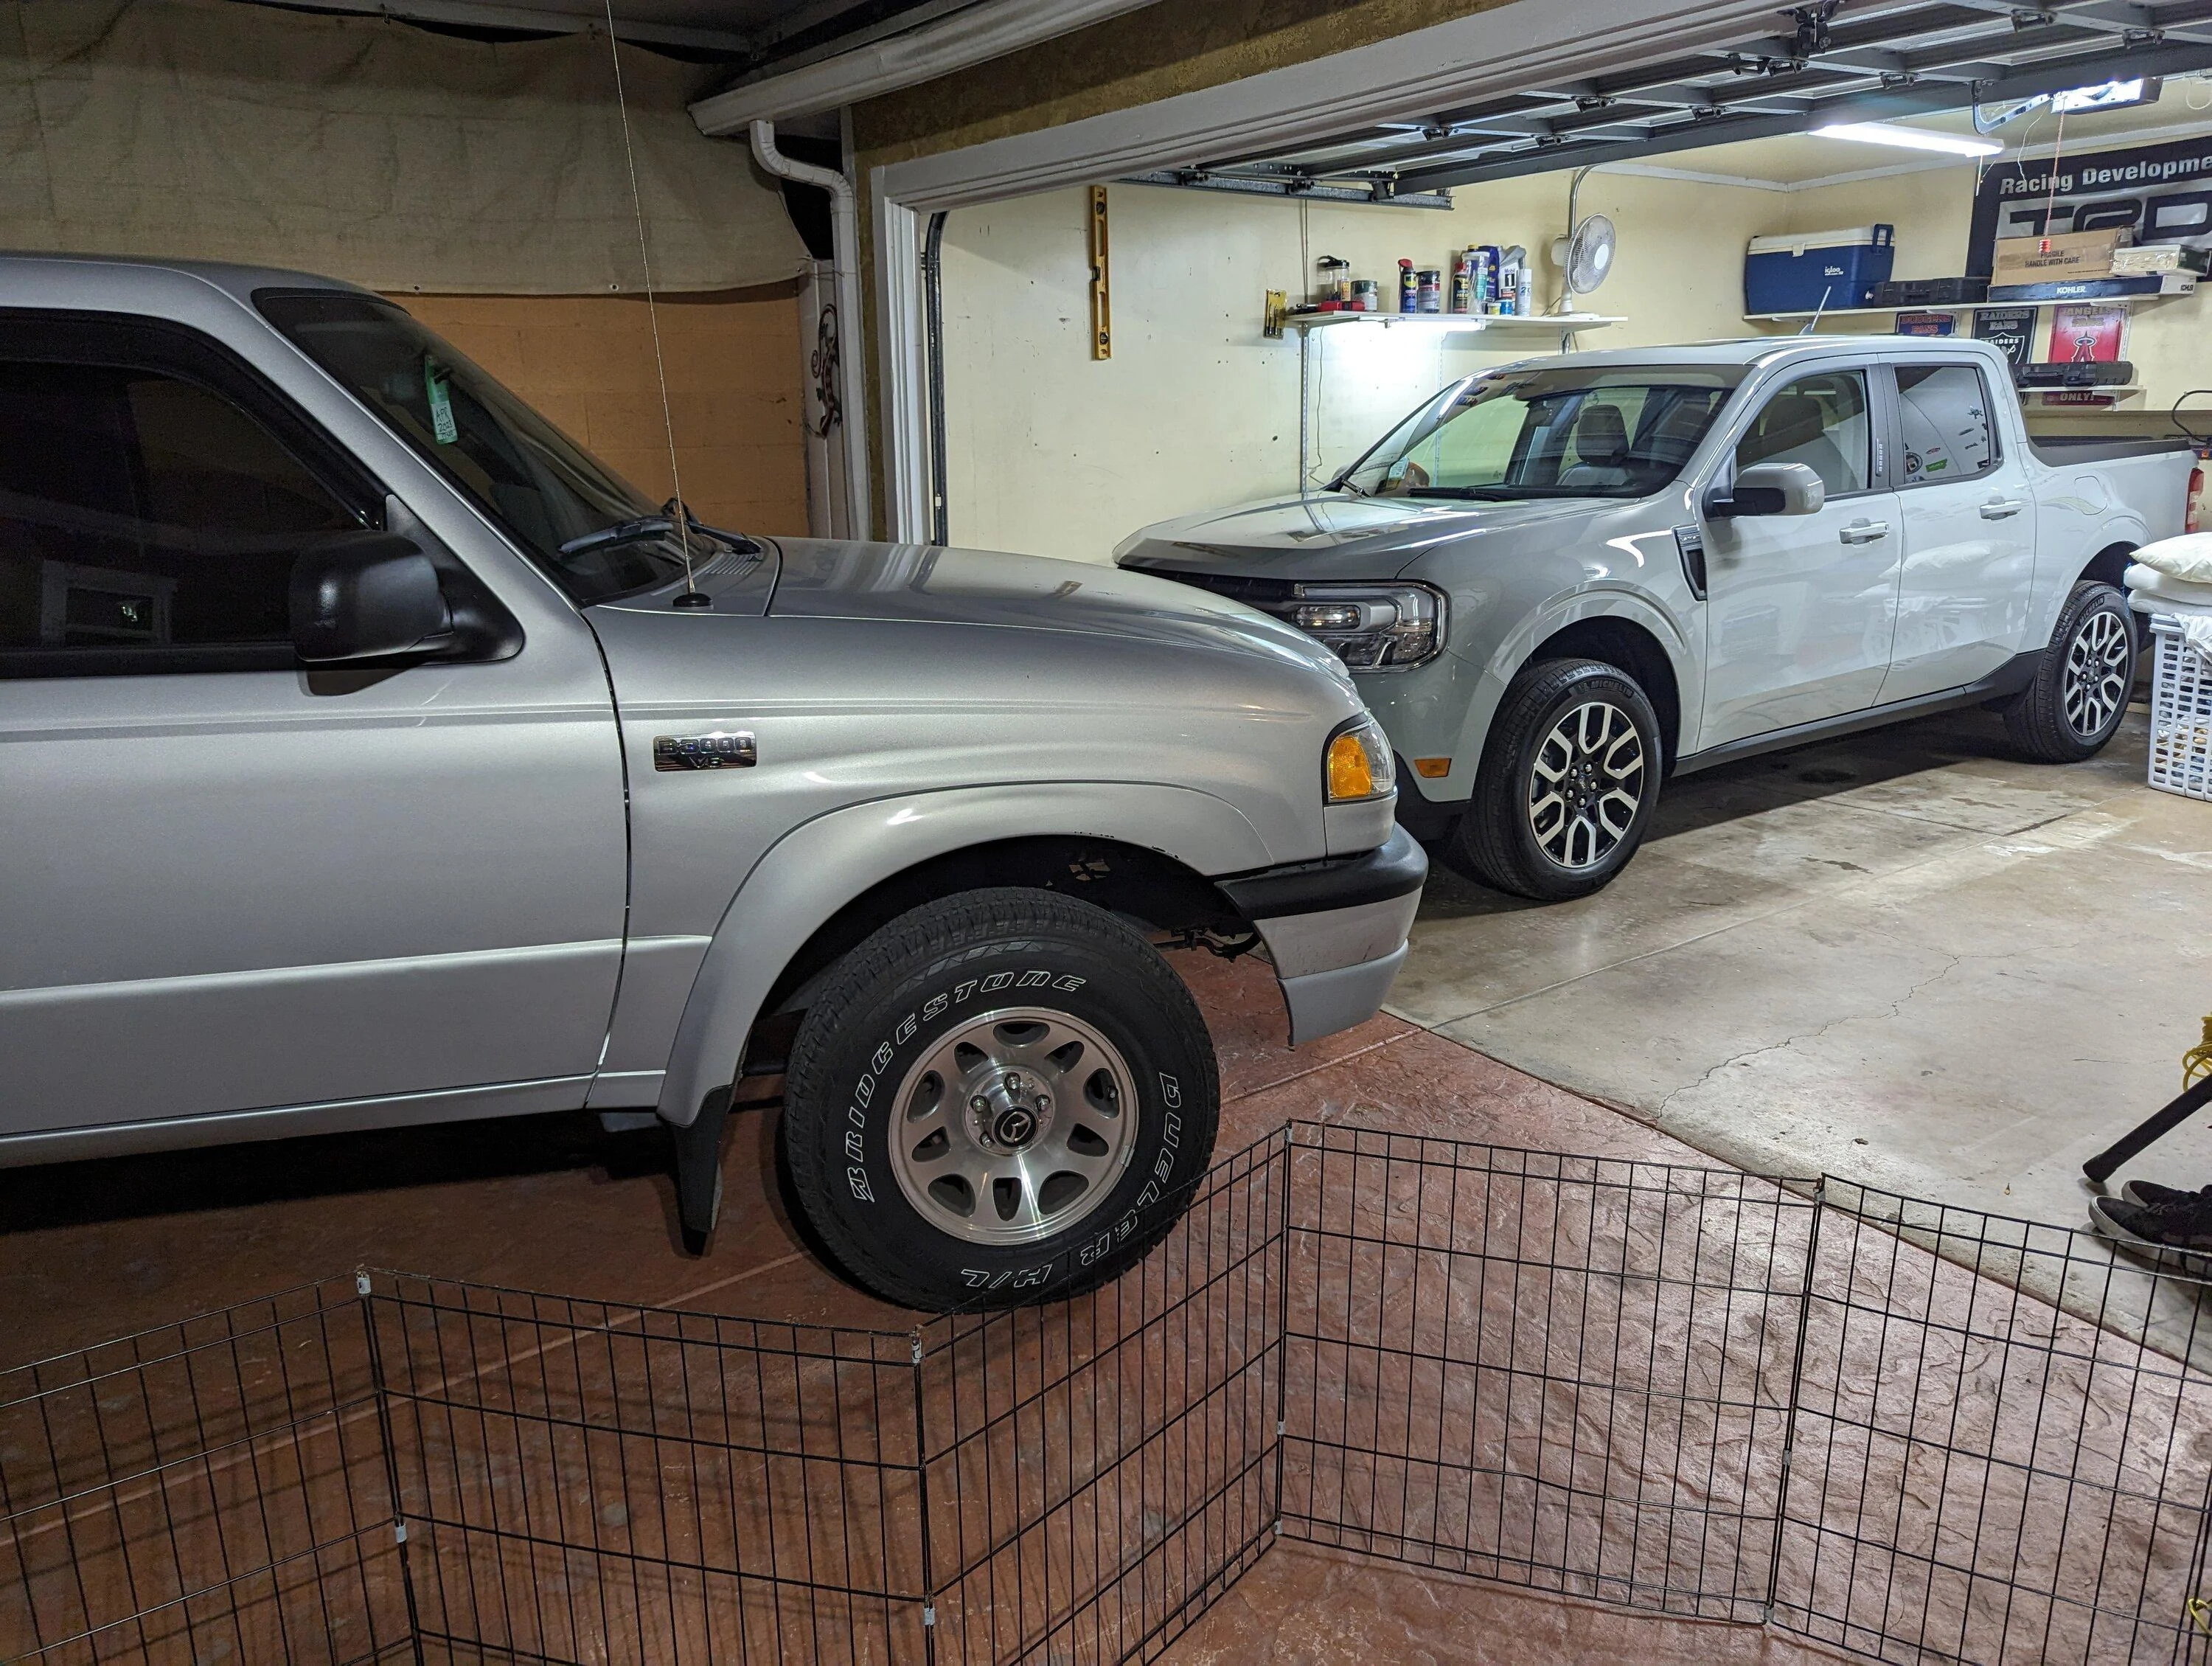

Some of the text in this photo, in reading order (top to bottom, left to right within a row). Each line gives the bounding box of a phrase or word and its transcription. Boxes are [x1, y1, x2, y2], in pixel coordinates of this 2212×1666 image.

[2000, 173, 2073, 195] Racing
[2025, 257, 2081, 268] HANDLE WITH CARE
[2056, 285, 2086, 294] KOHLER
[845, 970, 1087, 1203] BRIDGESTONE
[1079, 1071, 1182, 1266] DUELER
